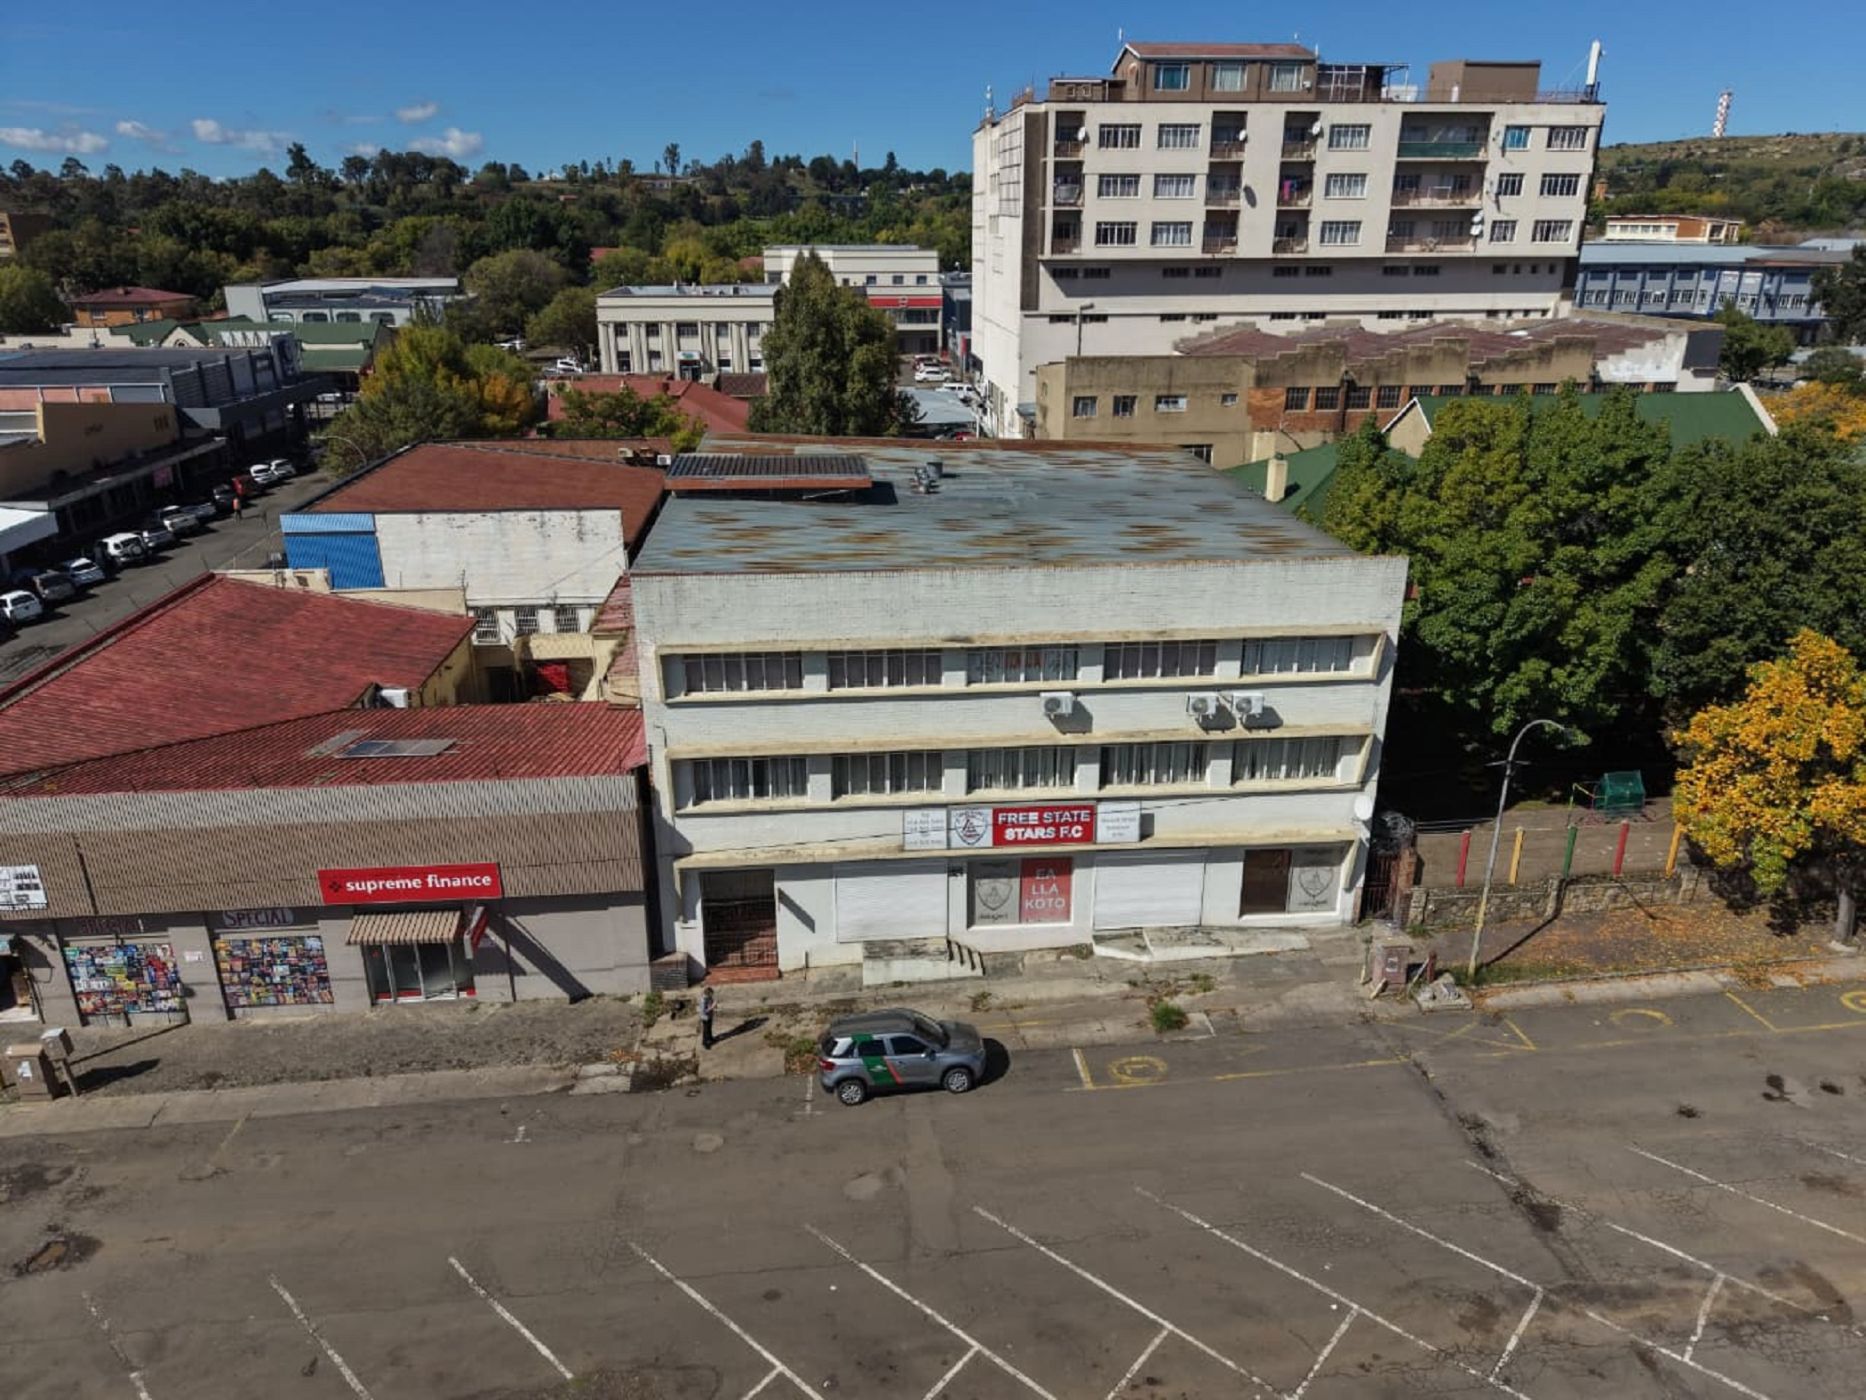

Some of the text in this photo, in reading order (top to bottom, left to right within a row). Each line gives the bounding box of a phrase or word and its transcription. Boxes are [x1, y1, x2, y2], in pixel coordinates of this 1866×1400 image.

[998, 812, 1039, 825] FREE
[1043, 810, 1091, 824] STATE
[1004, 825, 1083, 840] STARS F.C
[1035, 868, 1056, 880] EA
[345, 873, 492, 895] supreme finance
[1031, 883, 1059, 895] LLA
[1025, 898, 1066, 910] KOTO
